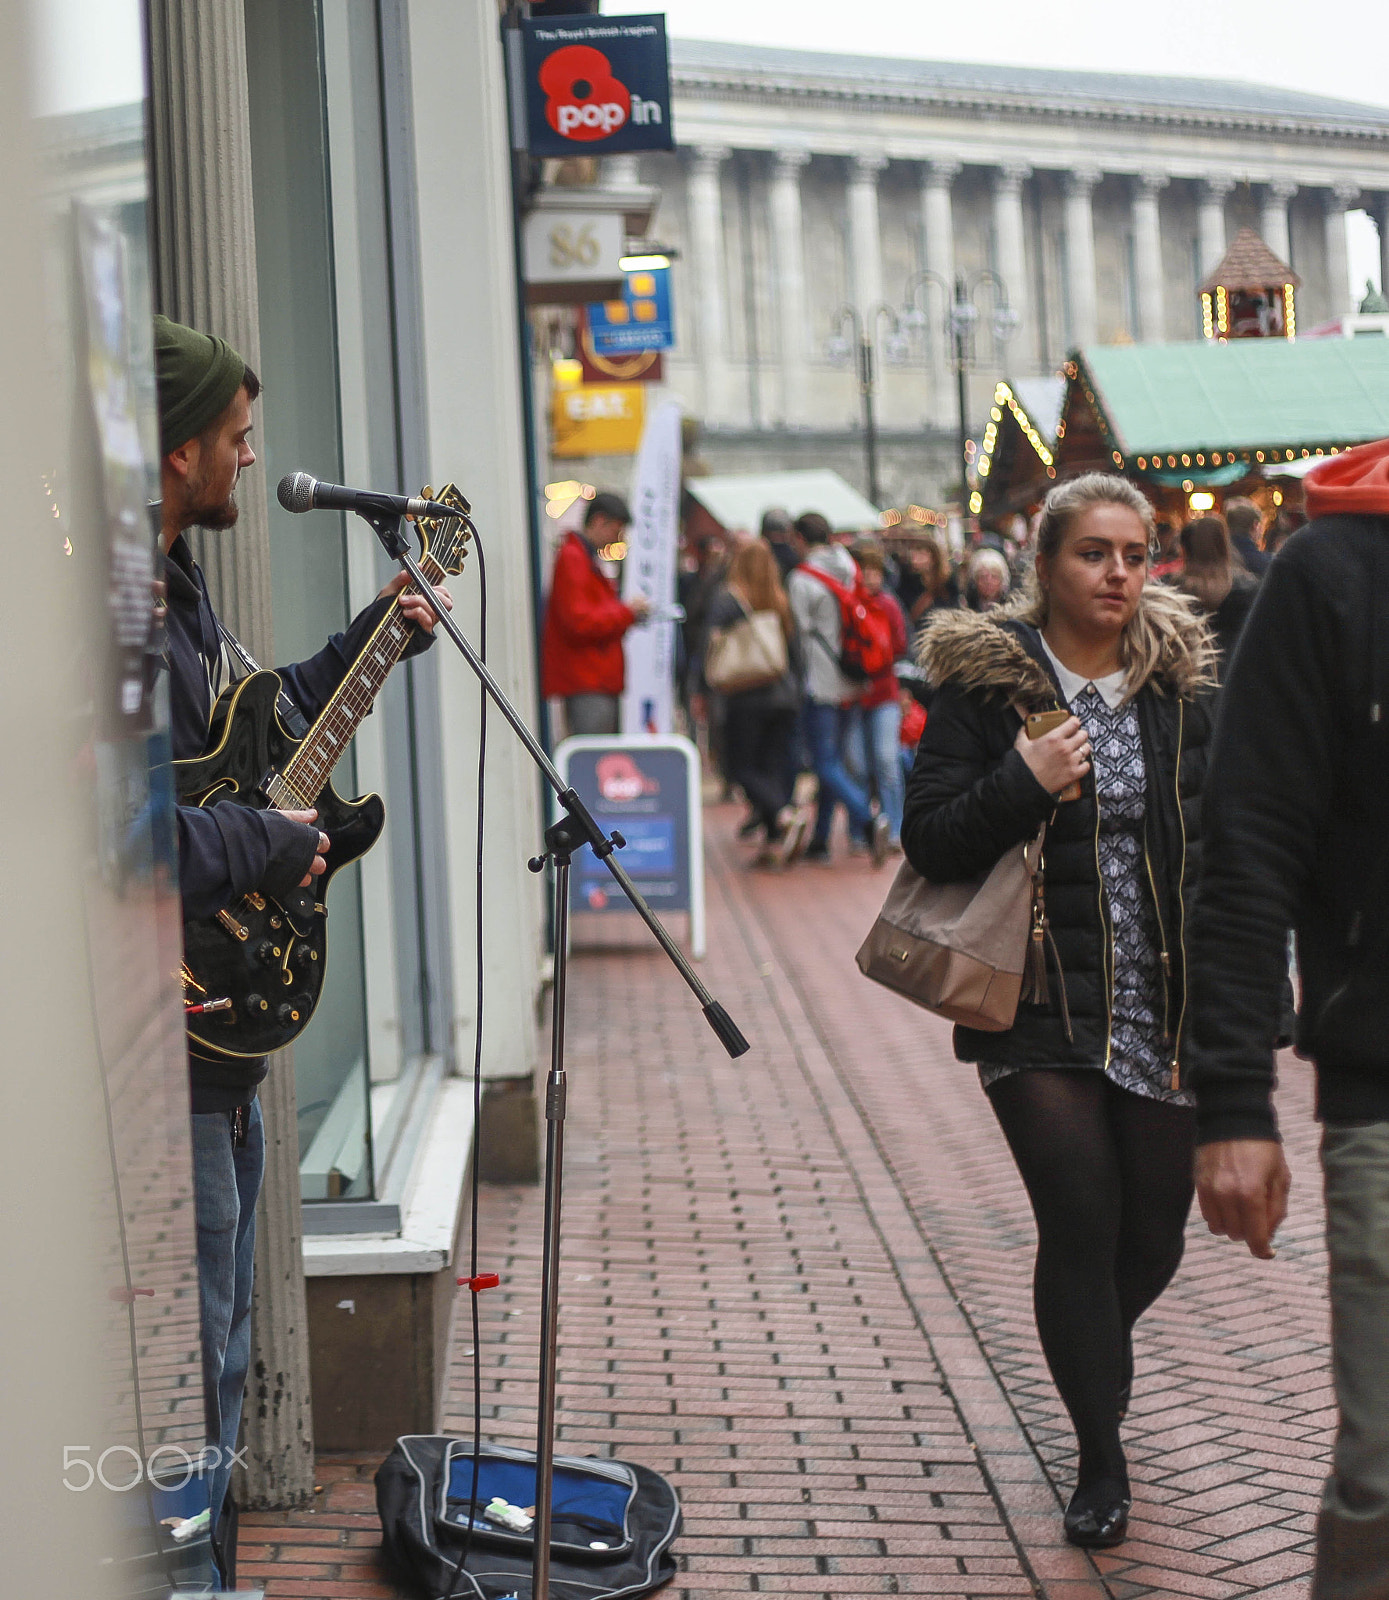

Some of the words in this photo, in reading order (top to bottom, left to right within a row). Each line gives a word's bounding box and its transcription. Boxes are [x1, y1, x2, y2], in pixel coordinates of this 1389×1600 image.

[557, 103, 625, 135] pop
[630, 95, 662, 125] in
[551, 222, 600, 268] 86
